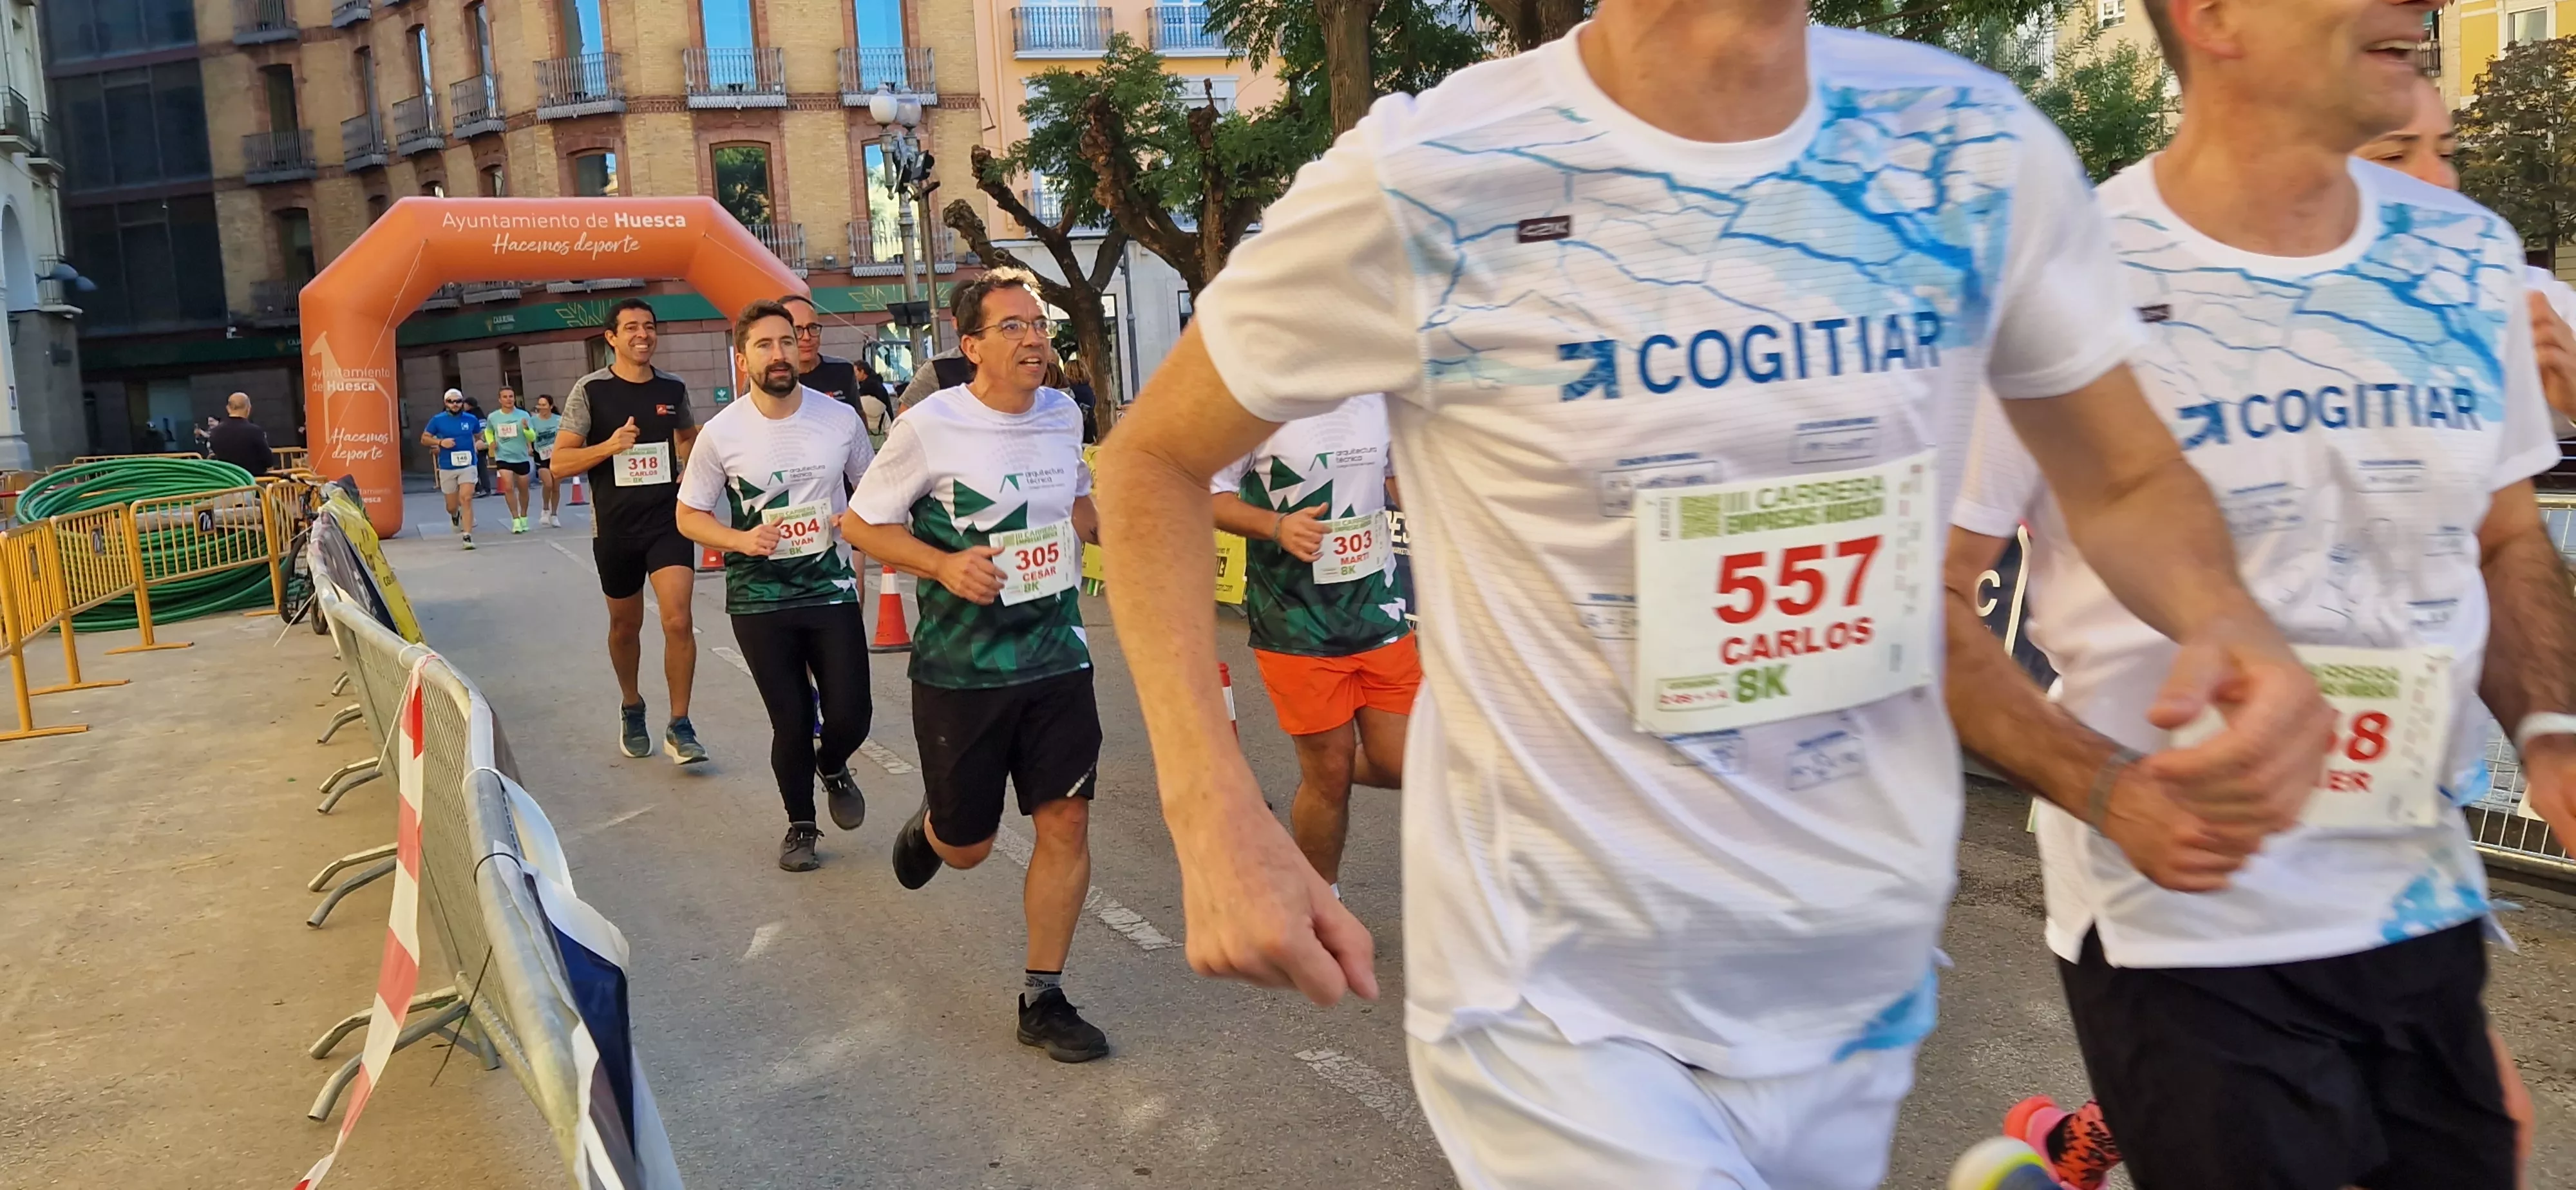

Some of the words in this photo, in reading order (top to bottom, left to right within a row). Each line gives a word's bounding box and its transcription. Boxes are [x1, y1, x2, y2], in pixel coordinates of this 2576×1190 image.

[442, 211, 580, 232] Ayuntamiento
[586, 212, 608, 228] de
[614, 212, 687, 228] Huesca
[492, 232, 570, 254] Hacemos
[574, 232, 640, 260] deporte
[1638, 311, 1943, 394] COGITIAR
[311, 367, 390, 380] Ayuntamiento
[312, 382, 323, 392] de
[327, 381, 375, 392] Huesca
[2239, 382, 2483, 439] COGITIAR
[330, 428, 389, 444] Hacemos
[332, 444, 383, 467] deporte
[628, 457, 658, 470] 318
[781, 518, 820, 539] 304
[791, 536, 814, 547] IVAN
[1332, 530, 1372, 555] 303
[1015, 542, 1059, 571] 305
[1340, 552, 1369, 565] MARTI
[1023, 567, 1056, 582] CESAR
[1341, 565, 1357, 575] 8K
[1714, 534, 1882, 624] 557
[1719, 617, 1875, 665] CARLOS
[1734, 664, 1790, 703] 8K
